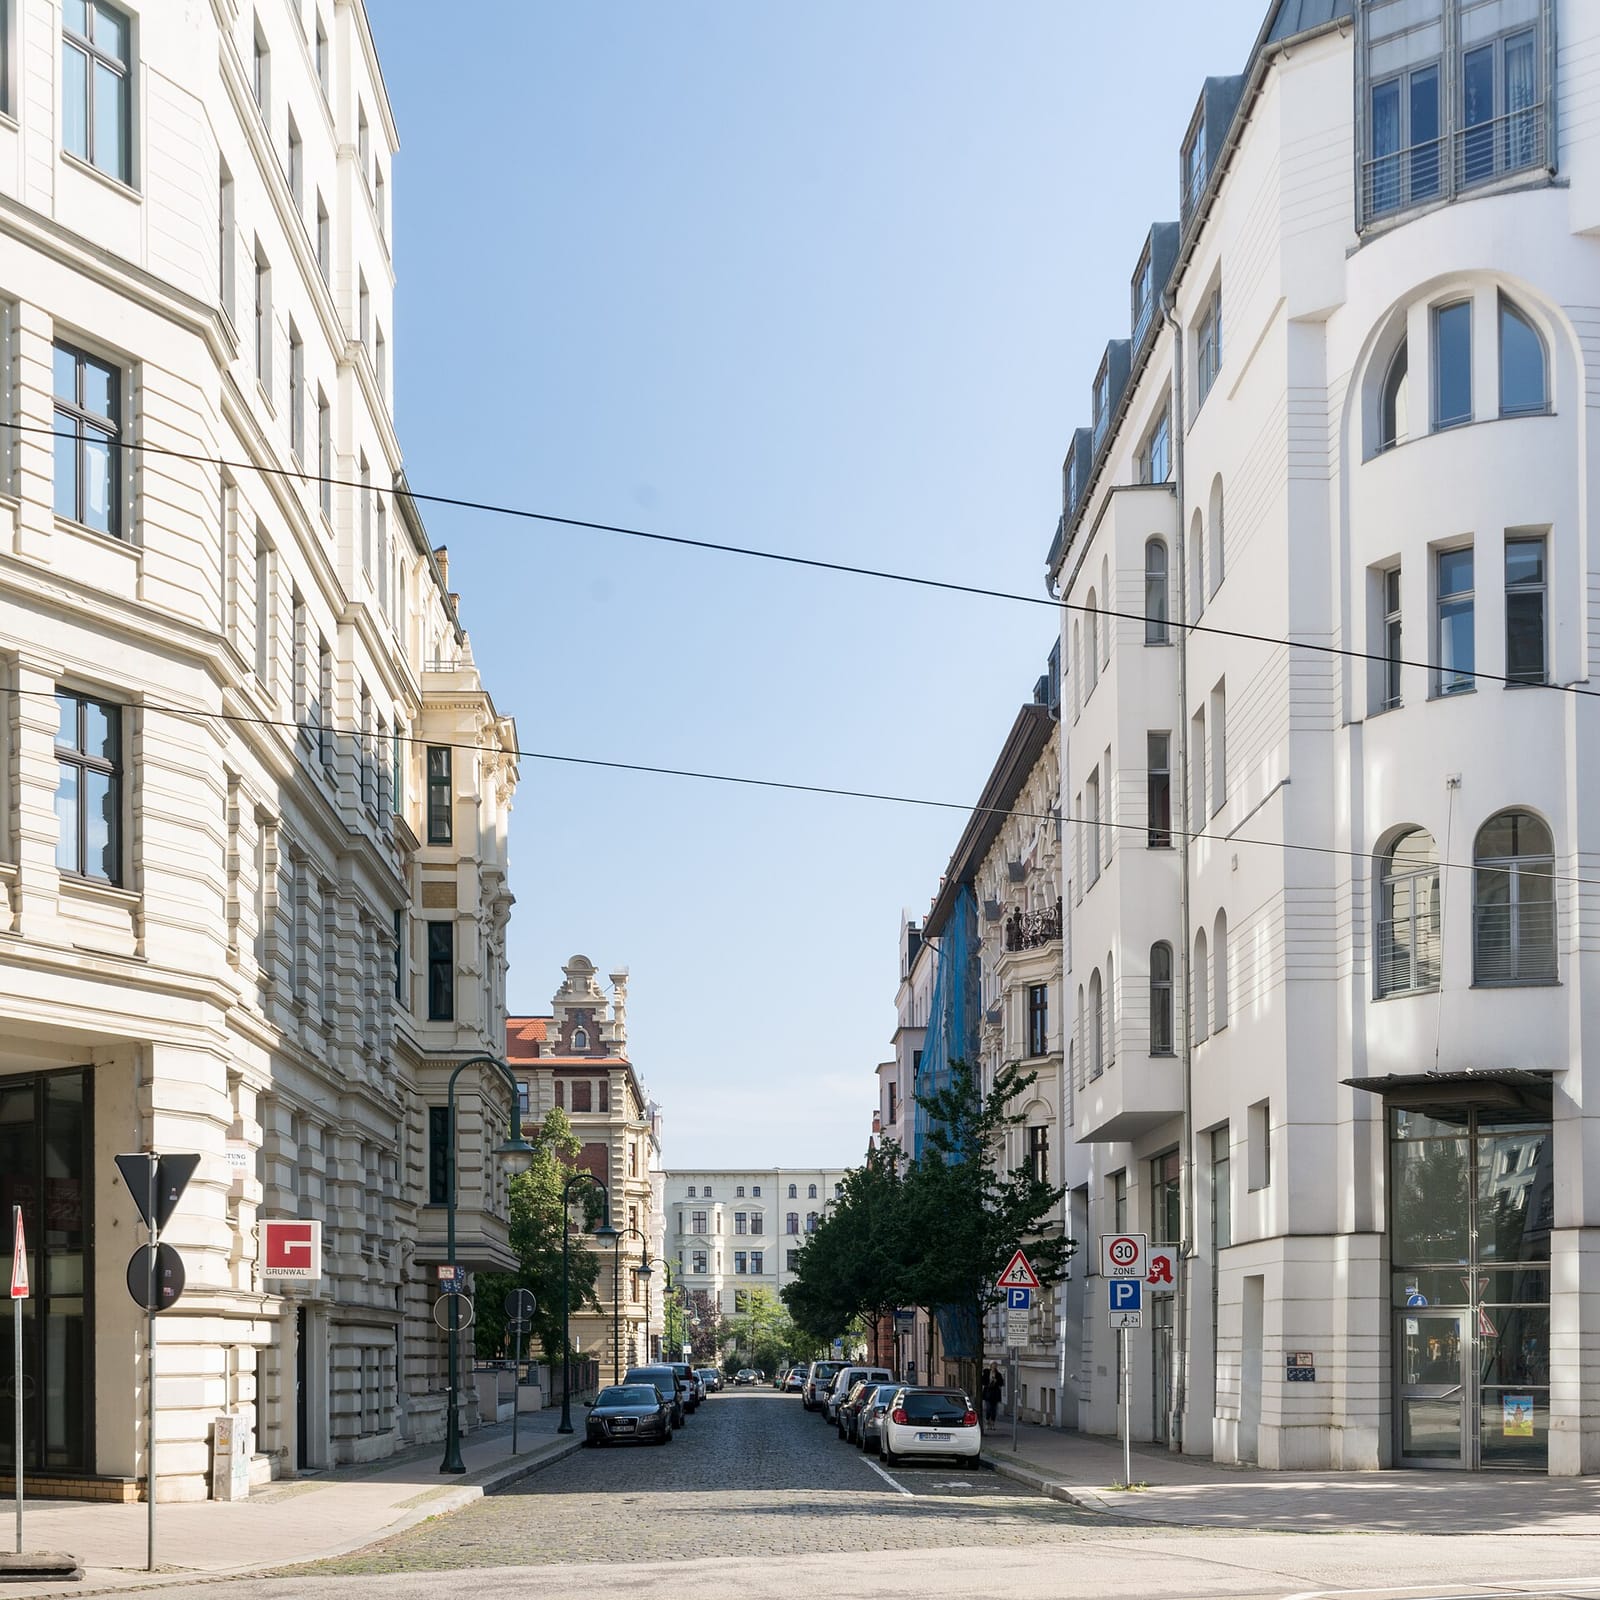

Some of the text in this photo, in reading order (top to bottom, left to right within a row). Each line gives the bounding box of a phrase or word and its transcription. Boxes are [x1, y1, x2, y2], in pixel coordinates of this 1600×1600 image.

[1115, 1245, 1133, 1259] 30
[1113, 1267, 1136, 1275] ZONE
[1012, 1290, 1025, 1307] P
[1116, 1283, 1134, 1307] P
